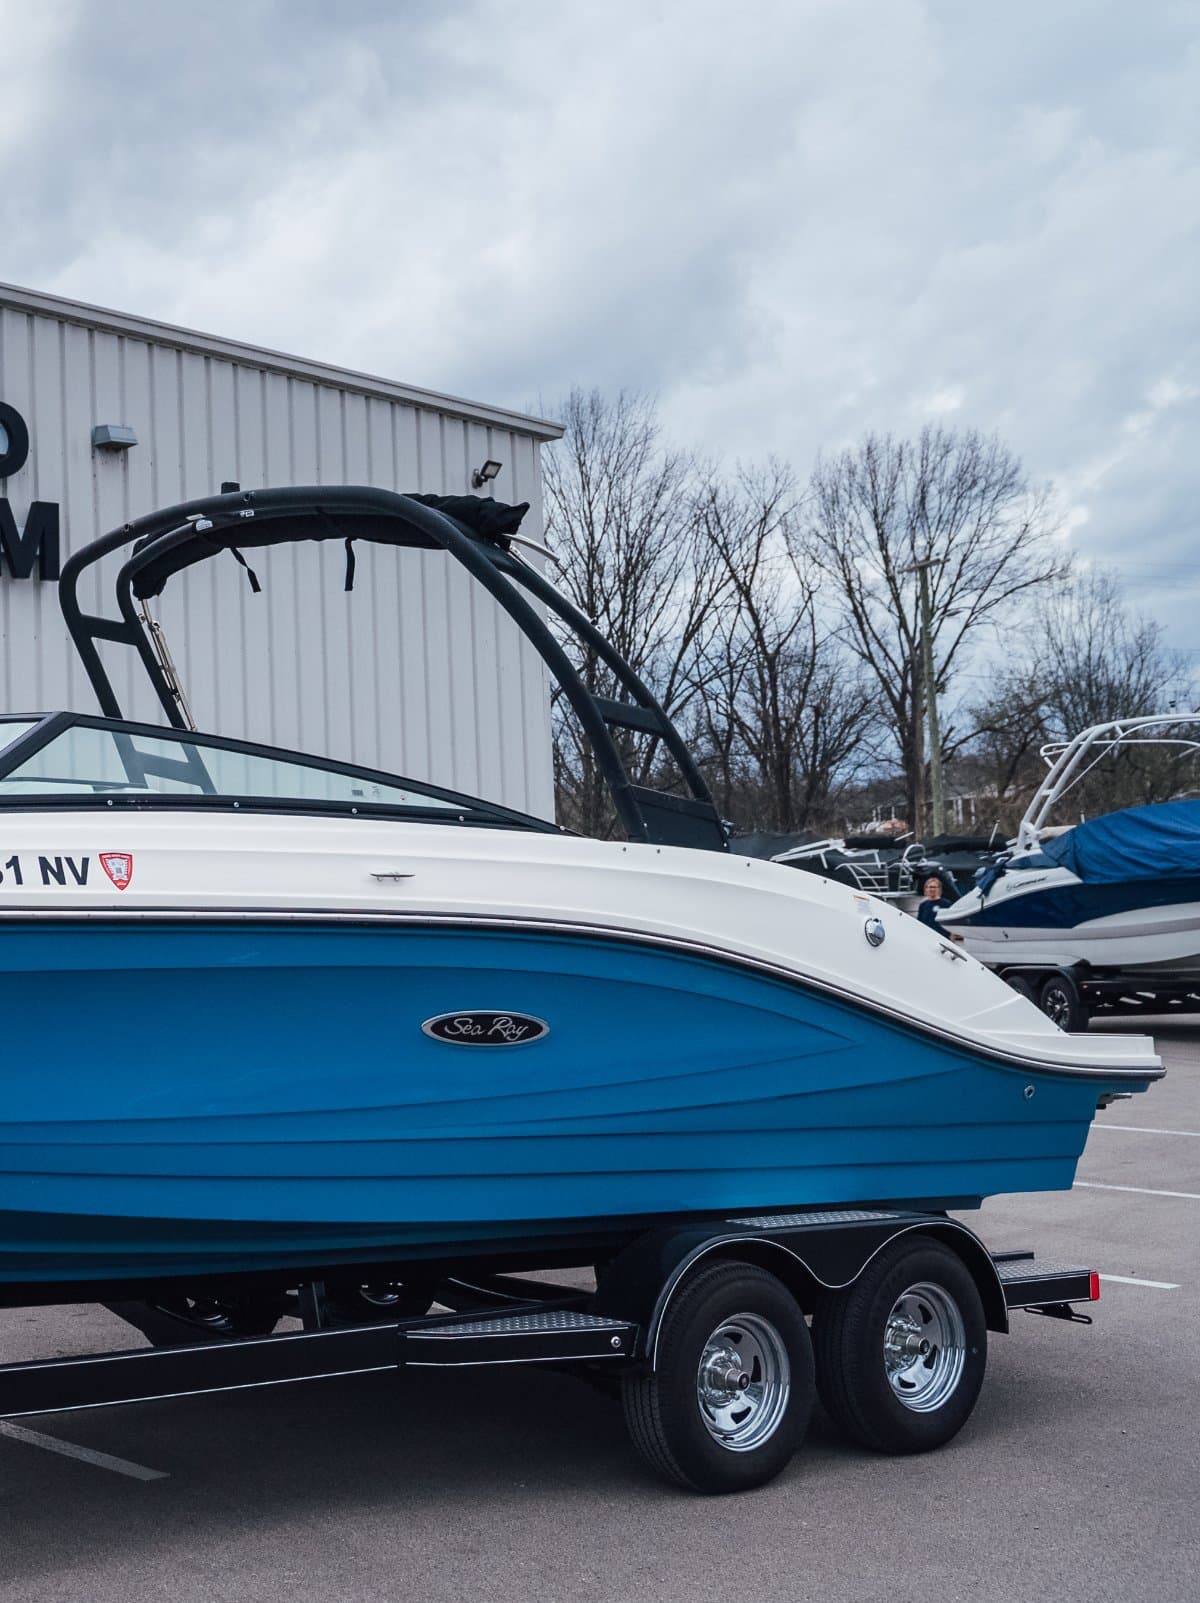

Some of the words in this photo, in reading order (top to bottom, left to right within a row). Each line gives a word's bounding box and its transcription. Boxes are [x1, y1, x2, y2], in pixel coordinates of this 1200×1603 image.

[37, 855, 90, 886] NV
[443, 1017, 486, 1036] Sea
[487, 1016, 529, 1041] Ray
